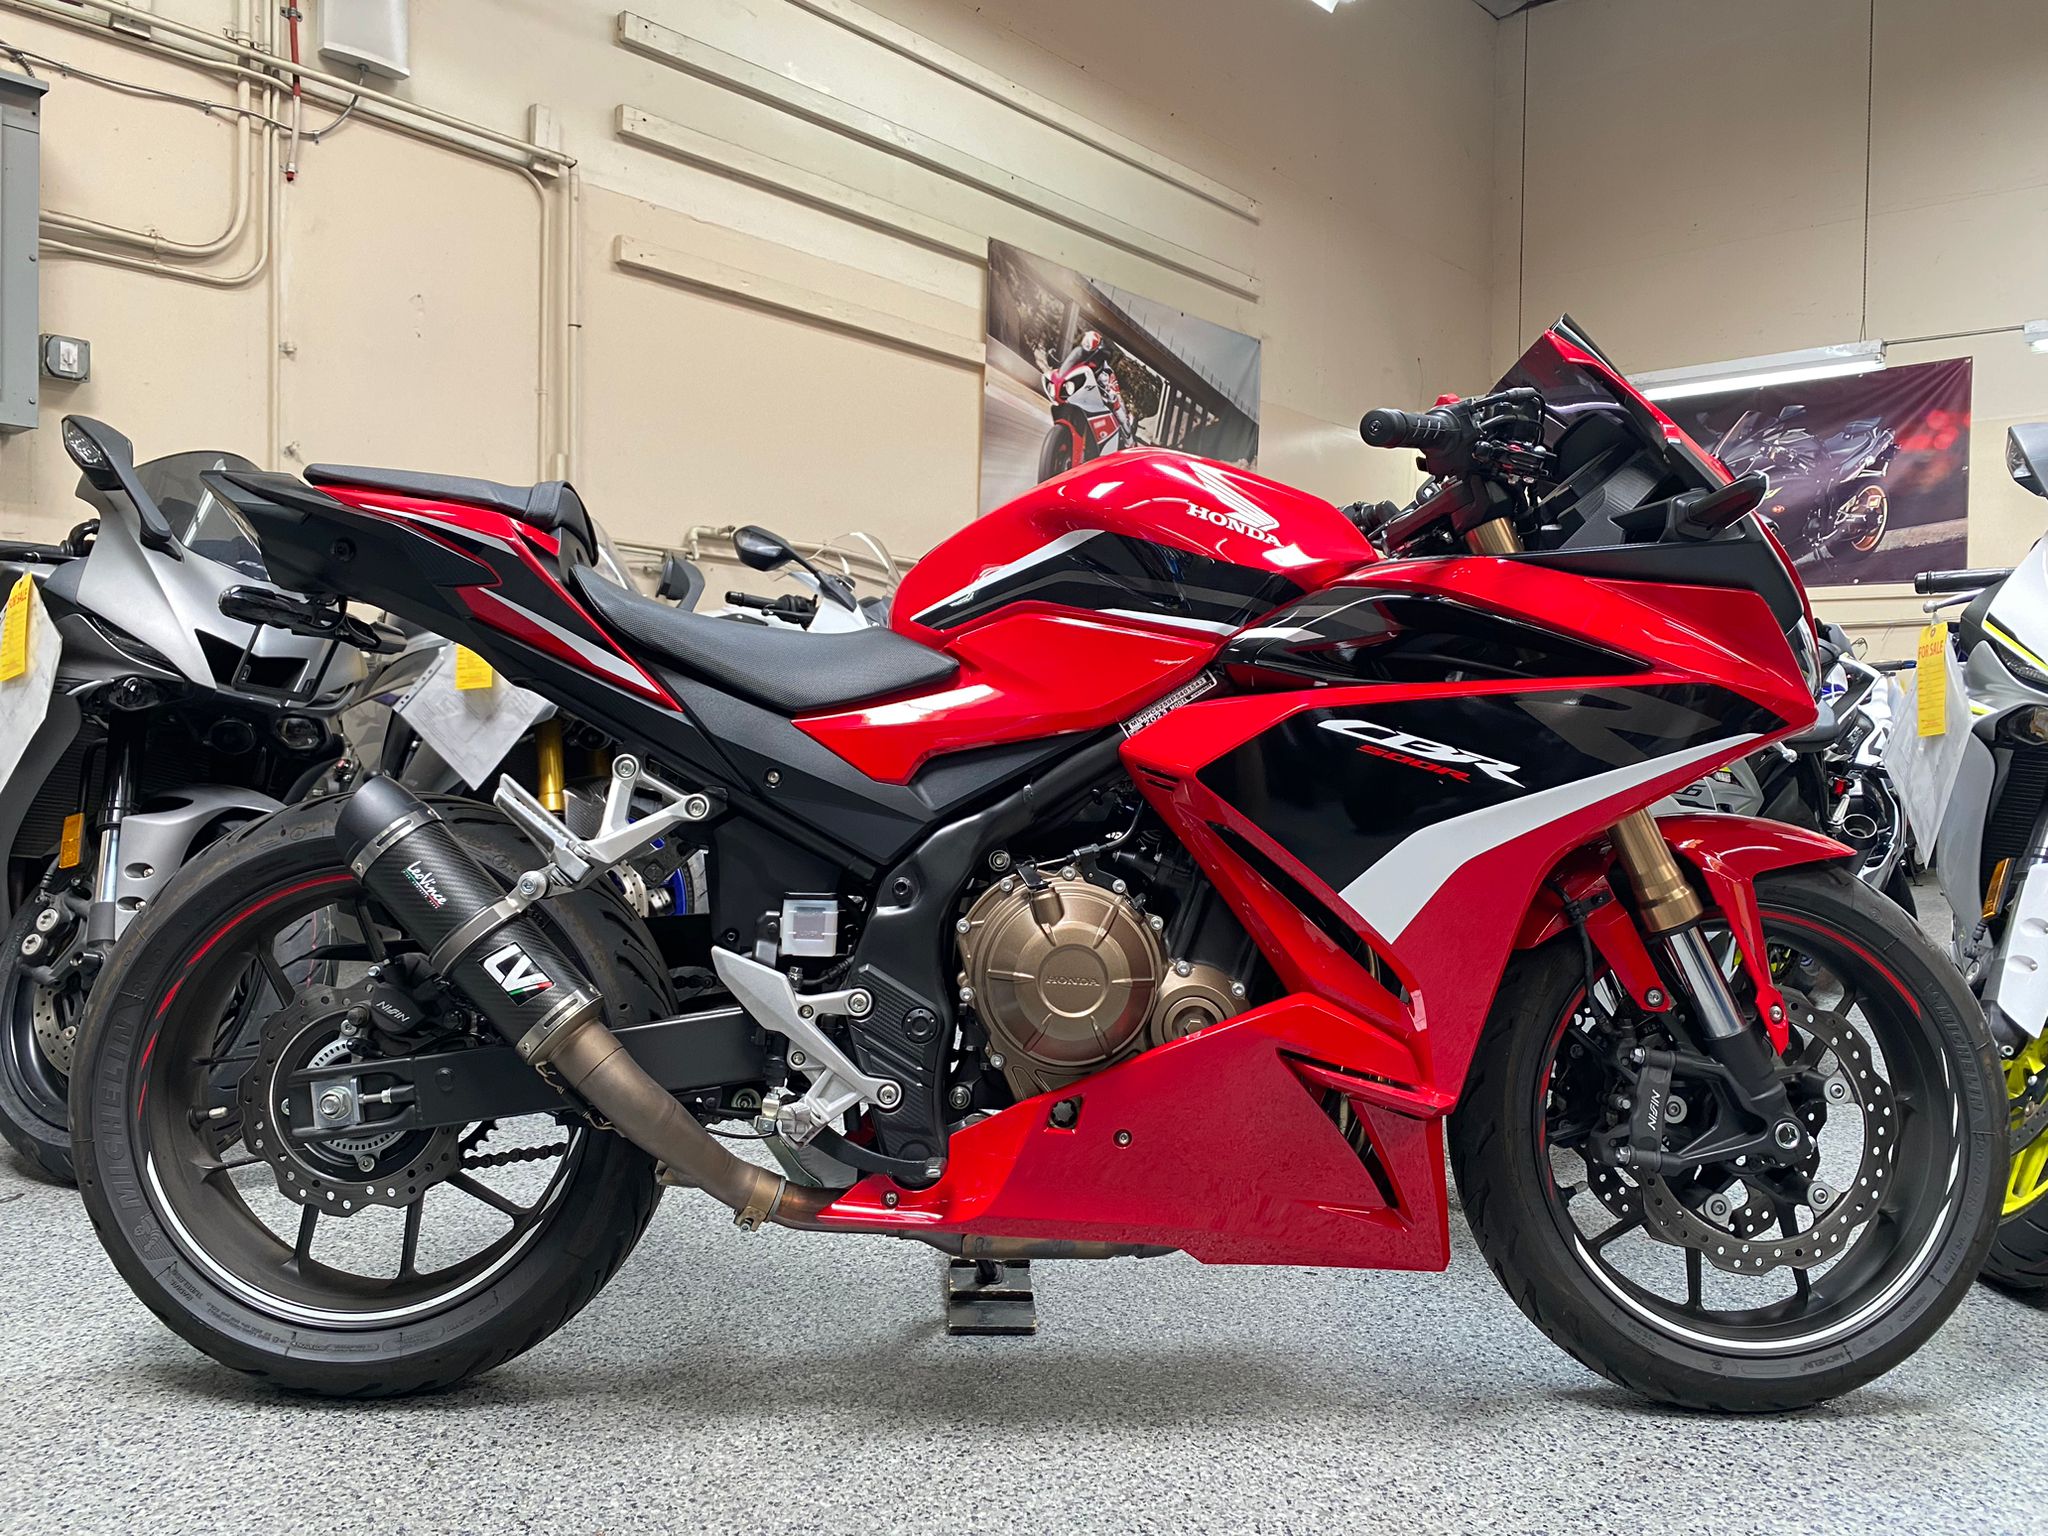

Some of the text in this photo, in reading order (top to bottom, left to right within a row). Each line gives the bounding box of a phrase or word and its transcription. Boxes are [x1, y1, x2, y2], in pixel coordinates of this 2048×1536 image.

[1186, 502, 1285, 548] HONDA
[1918, 640, 1944, 658] FOR SALE
[1145, 709, 1168, 727] 2023
[1317, 719, 1526, 788] CBR
[1356, 744, 1471, 783] 500R
[406, 860, 447, 905] LeoVince
[483, 943, 551, 992] LV
[1045, 976, 1101, 987] HONDA
[376, 1000, 411, 1022] NISSIN
[1936, 1004, 1985, 1112] MICHELIN
[100, 1016, 143, 1211] MICHELIN
[1647, 1088, 1661, 1131] NISSIN
